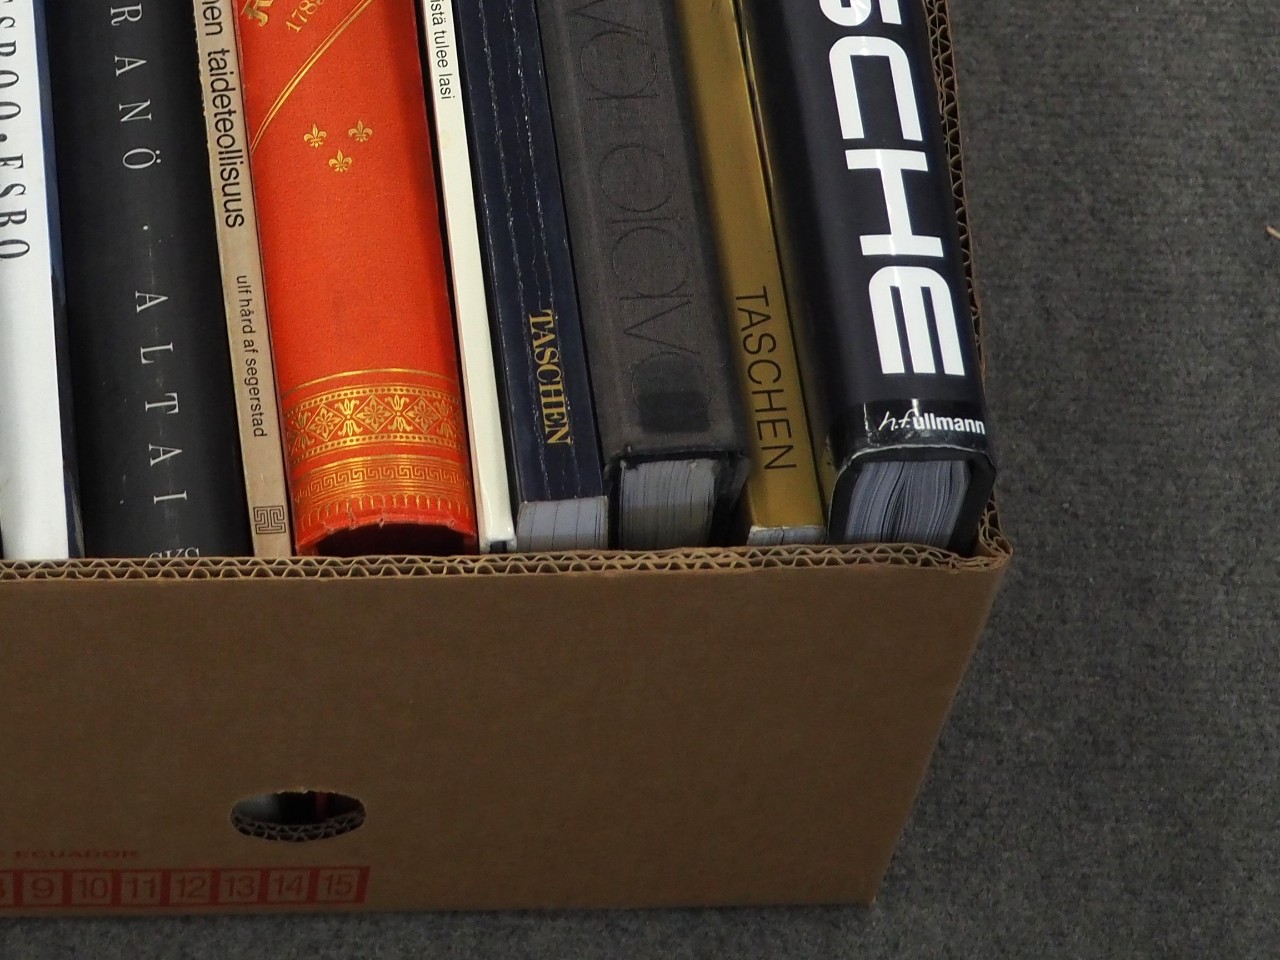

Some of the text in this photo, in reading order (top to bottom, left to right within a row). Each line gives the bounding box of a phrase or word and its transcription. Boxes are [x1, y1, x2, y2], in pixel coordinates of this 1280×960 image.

[433, 30, 450, 68] tulee
[438, 73, 455, 100] lasi
[207, 48, 245, 228] taideteollisuus
[135, 290, 188, 504] ALTAI
[236, 274, 268, 437] ulf hård af segerstad
[528, 309, 573, 445] TASCHEN
[736, 286, 797, 471] TASCHEN
[15, 849, 139, 859] ECUADOR
[30, 877, 55, 900] 9
[78, 877, 108, 899] 10
[129, 876, 156, 898] 11
[176, 876, 207, 899] 12
[224, 876, 254, 898] 13
[273, 875, 303, 896] 14
[323, 874, 353, 895] 15
